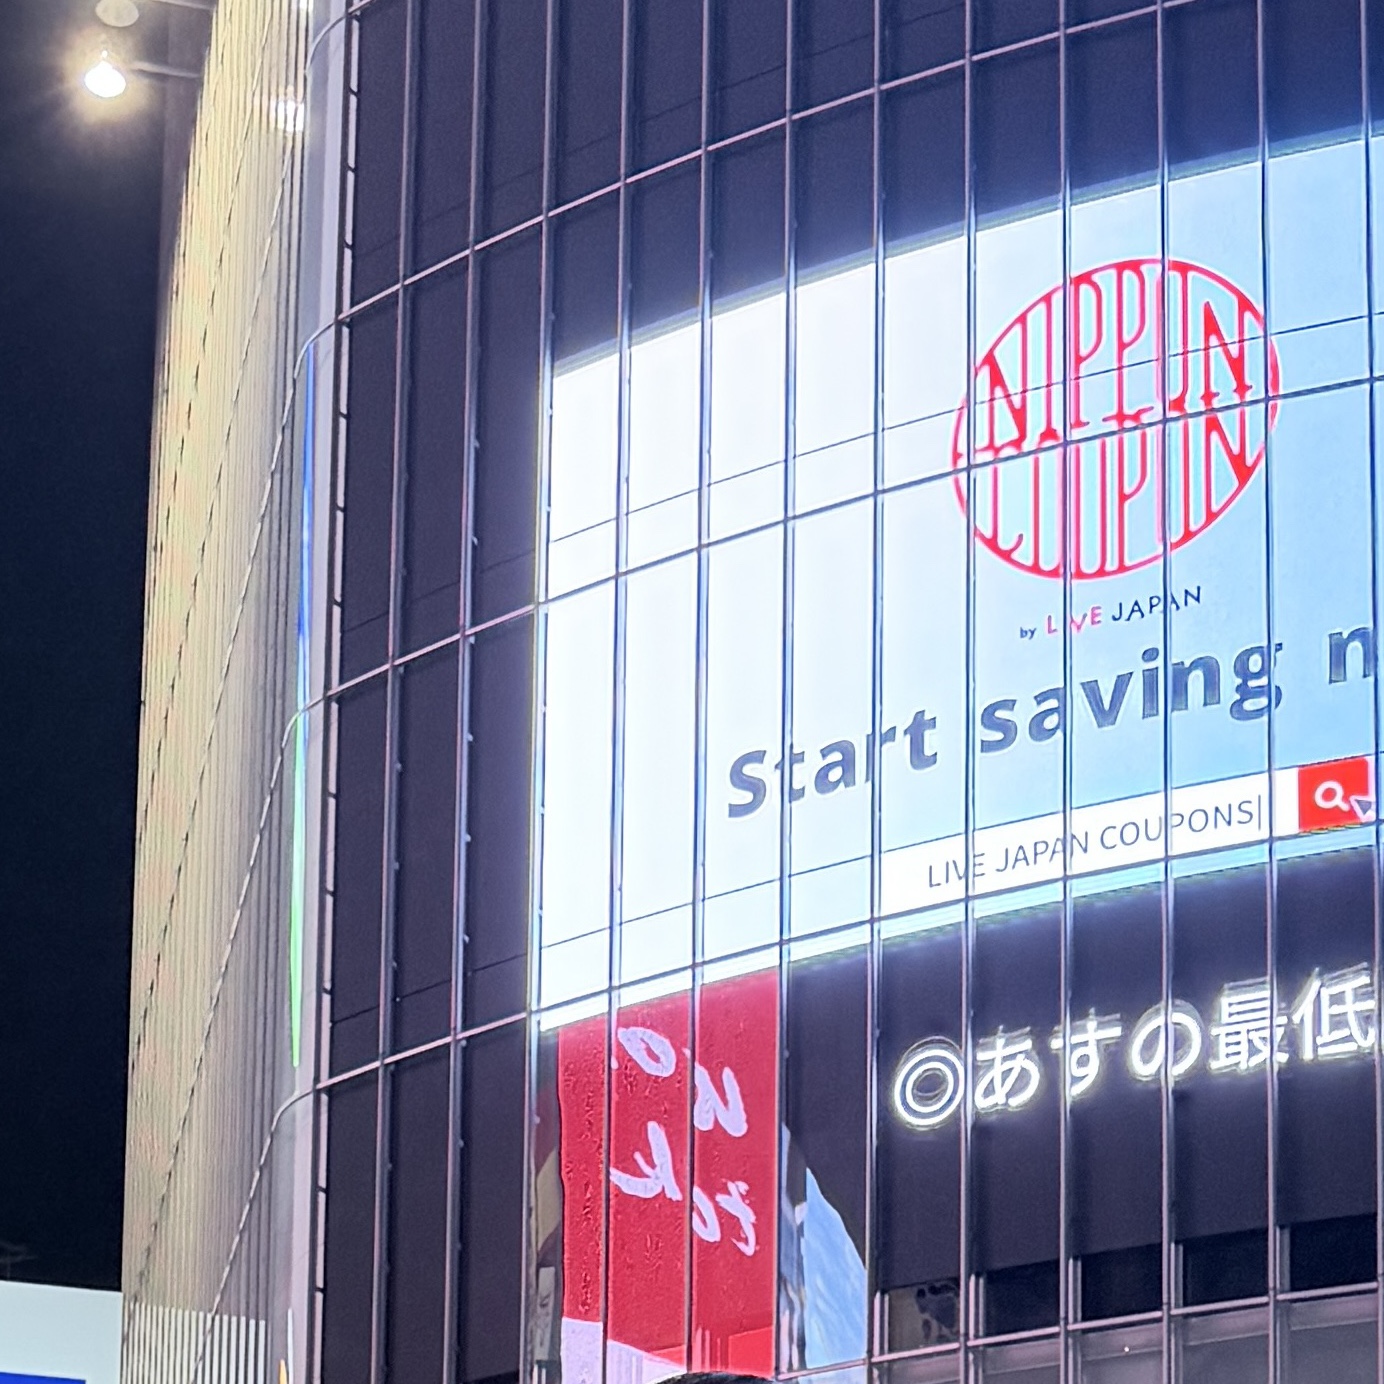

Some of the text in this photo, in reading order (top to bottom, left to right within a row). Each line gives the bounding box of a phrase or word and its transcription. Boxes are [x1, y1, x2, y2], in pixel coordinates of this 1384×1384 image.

[1019, 585, 1202, 639] by LVE JAPAN
[726, 707, 939, 818] Start
[979, 642, 1283, 754] saving
[927, 798, 1255, 889] LIVE JAPAN COUPONS
